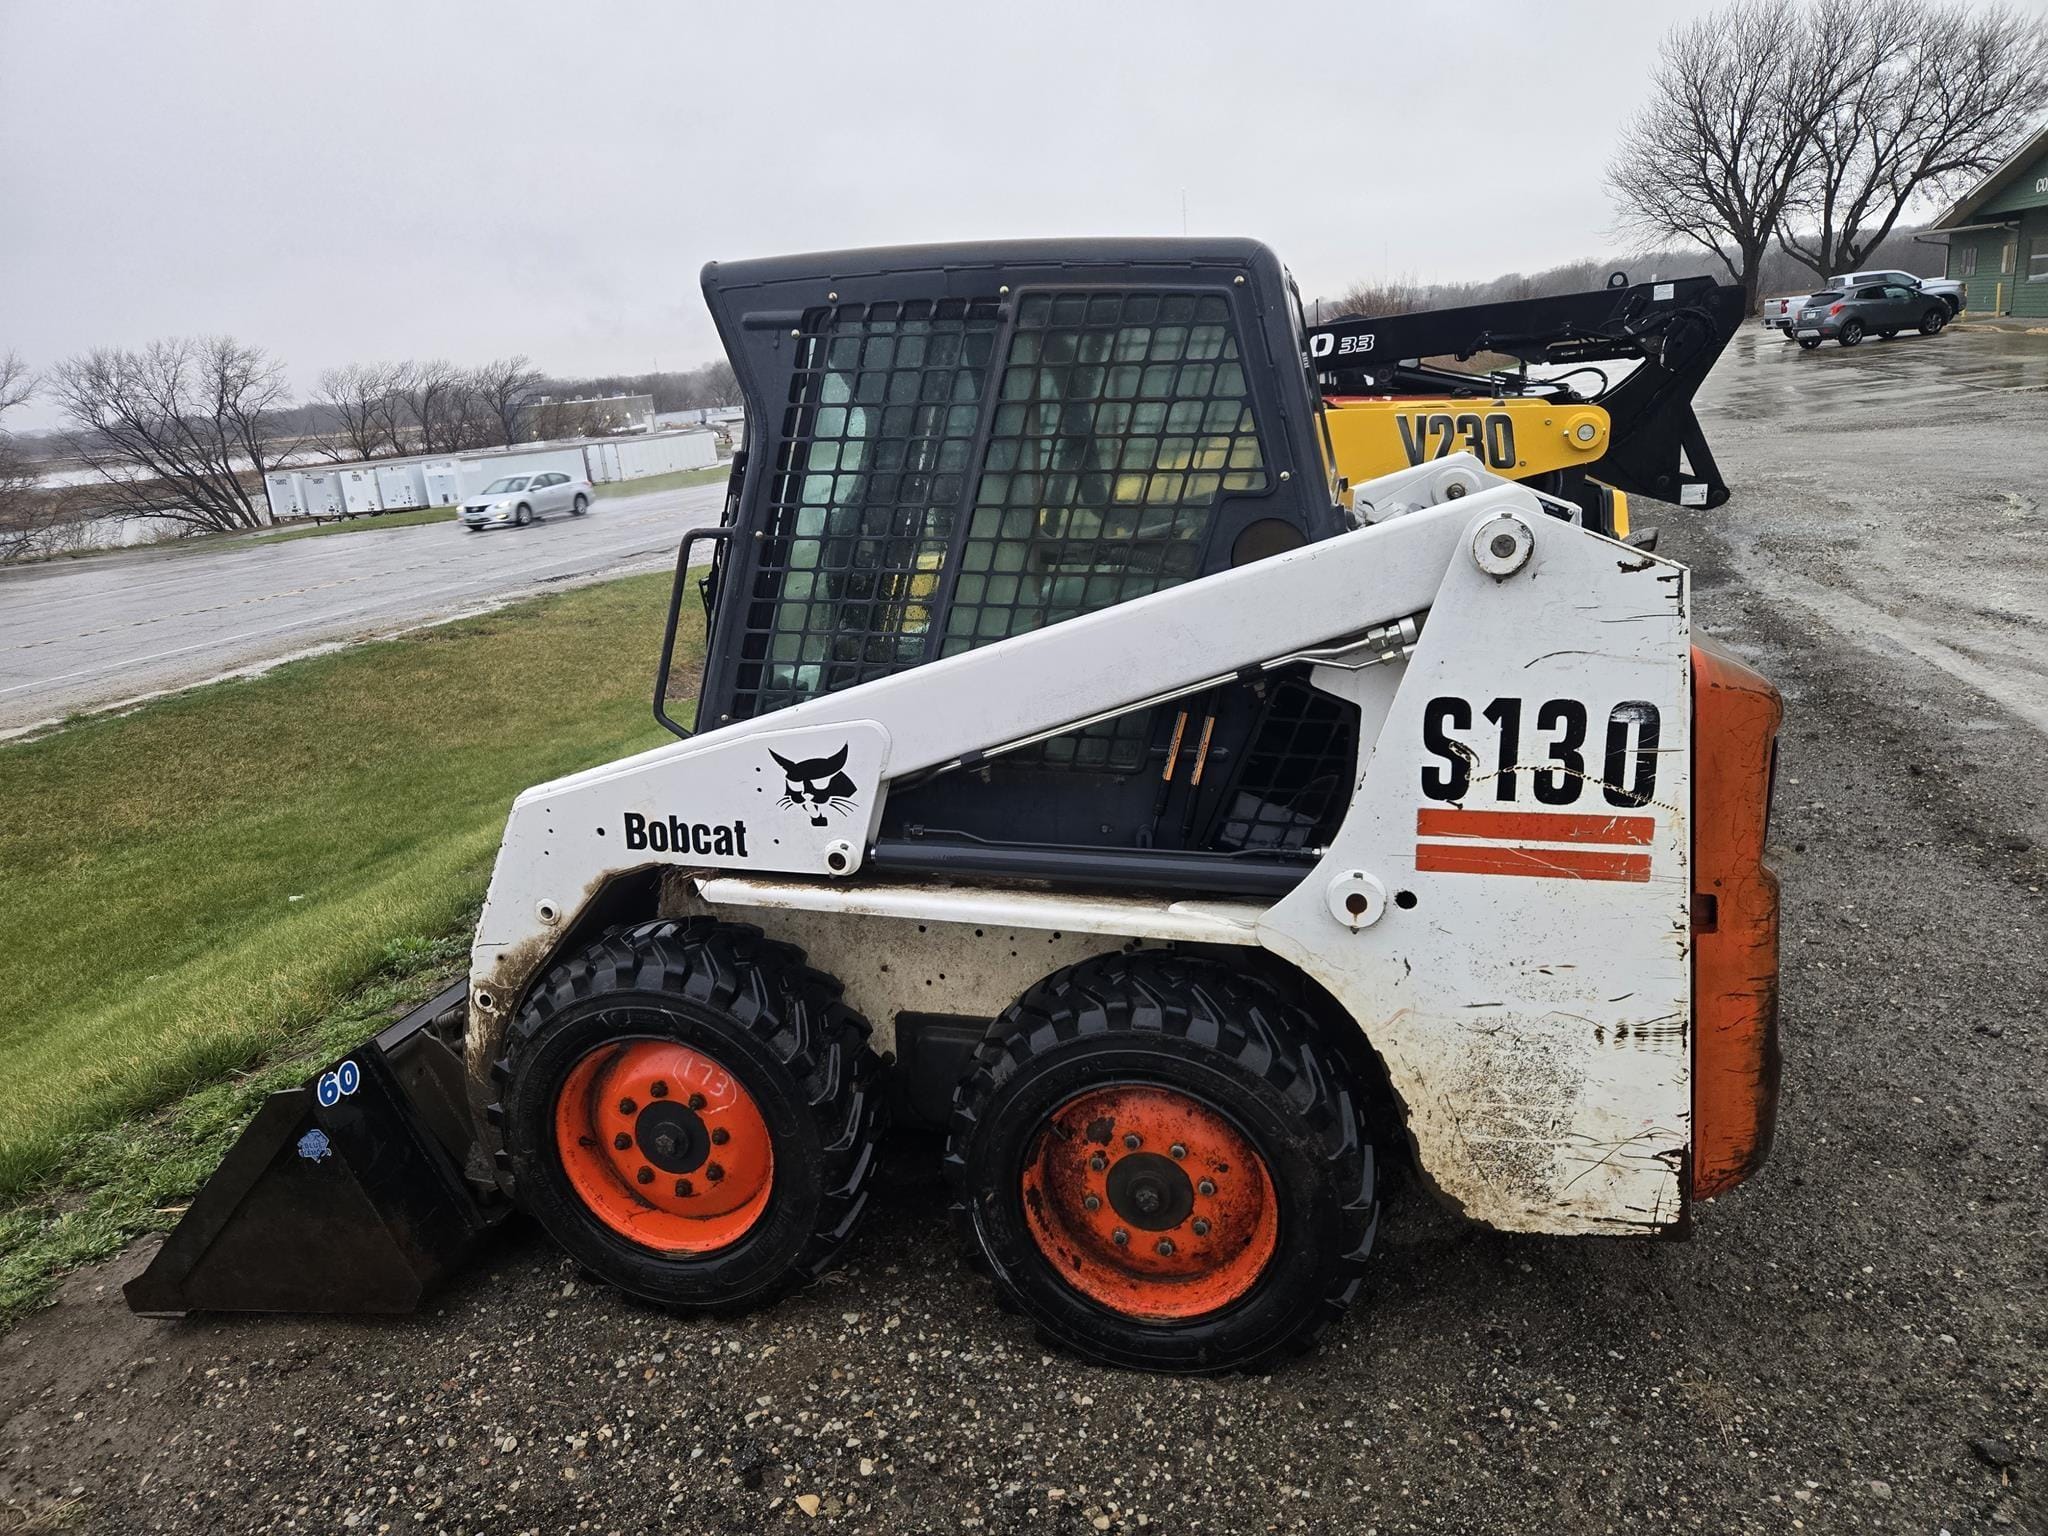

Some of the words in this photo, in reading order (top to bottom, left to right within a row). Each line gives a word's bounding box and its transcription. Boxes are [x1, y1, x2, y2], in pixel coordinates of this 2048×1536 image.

[2036, 177, 2048, 192] CO
[1338, 333, 1375, 355] 33
[1395, 412, 1517, 469] V230
[1421, 697, 1661, 808] S130
[624, 812, 748, 857] Bobcat
[317, 1060, 360, 1107] 60
[684, 1056, 729, 1097] 173
